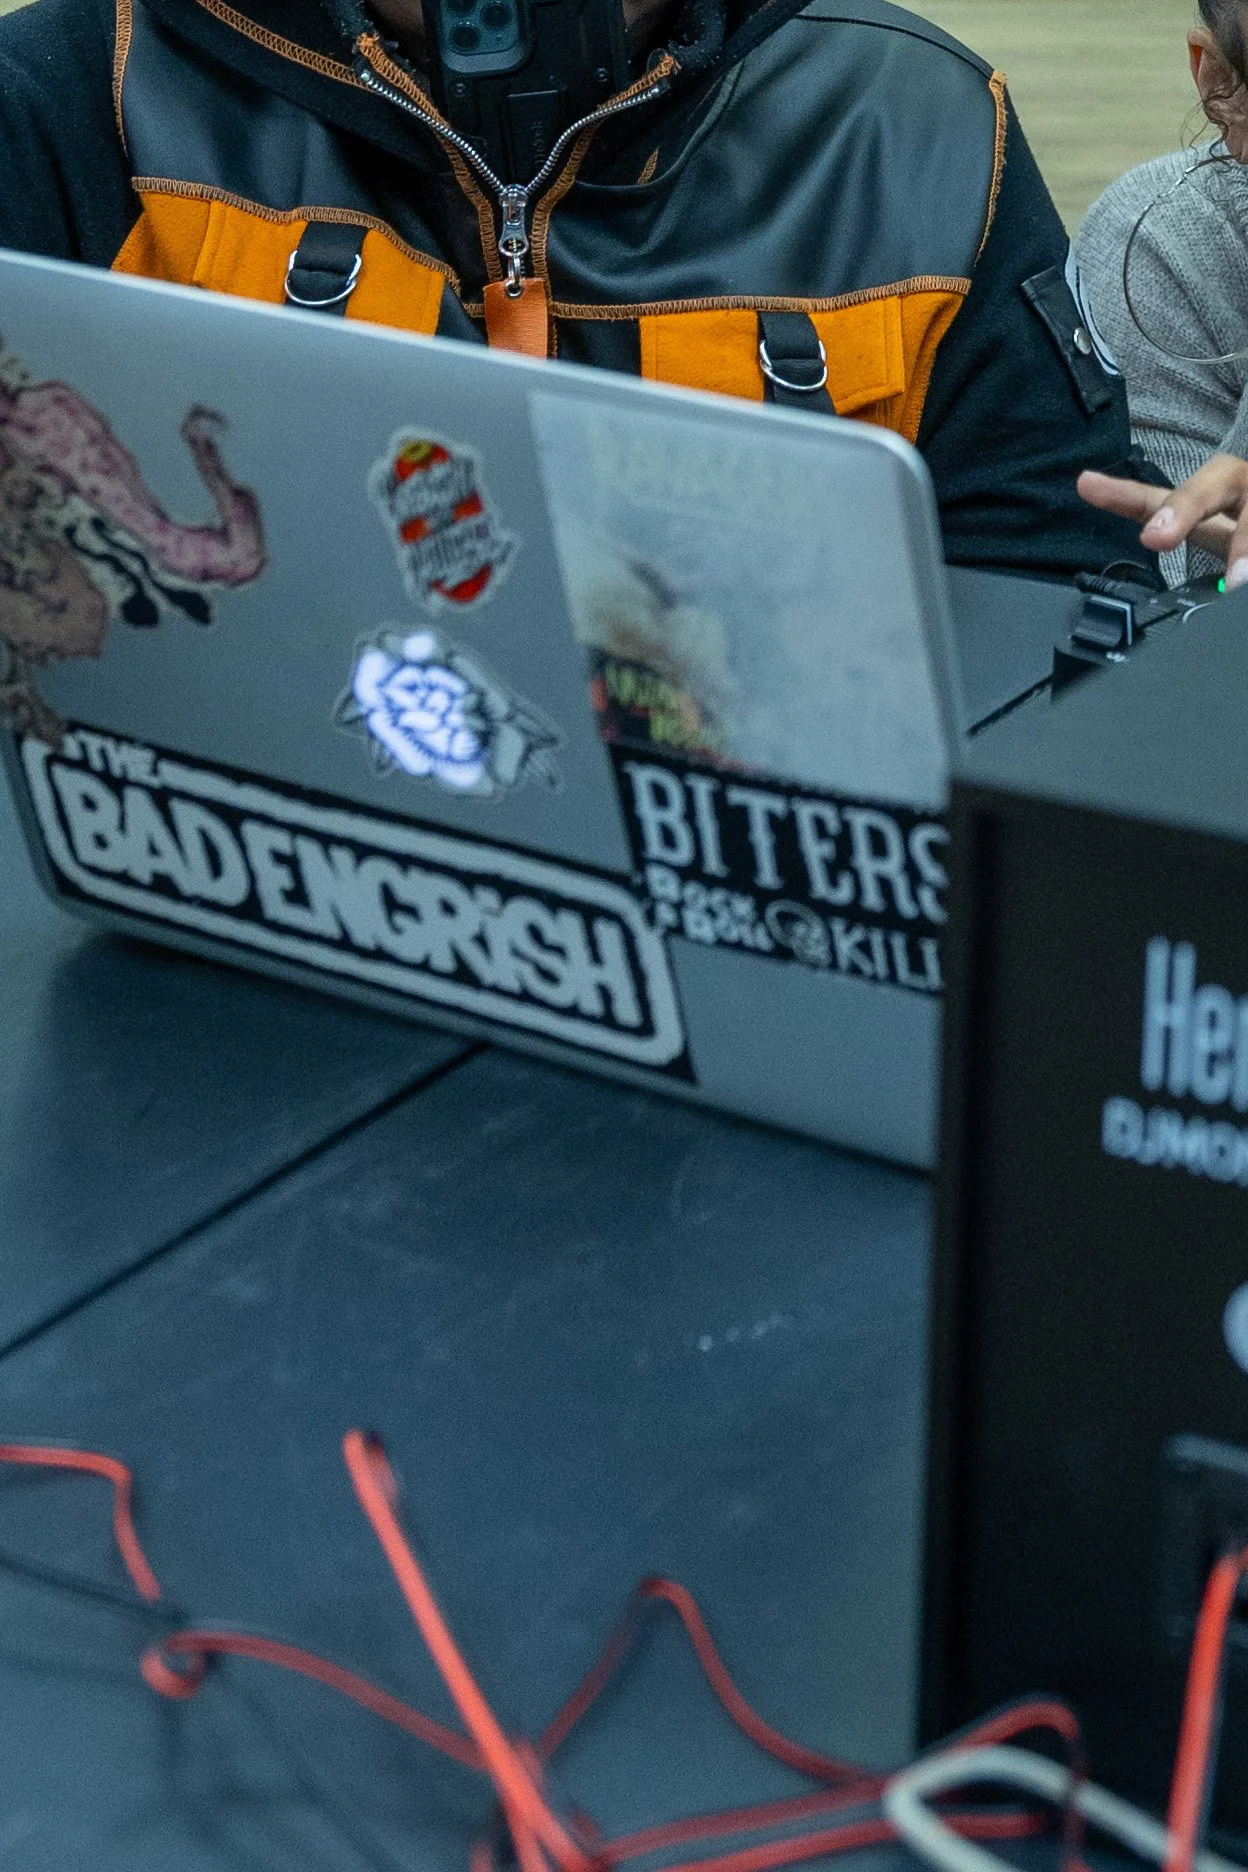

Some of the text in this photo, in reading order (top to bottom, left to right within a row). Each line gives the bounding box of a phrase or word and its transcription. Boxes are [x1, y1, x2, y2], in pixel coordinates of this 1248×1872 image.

[68, 735, 156, 781] THE
[53, 771, 251, 909] BAD
[625, 763, 948, 922] BITERS
